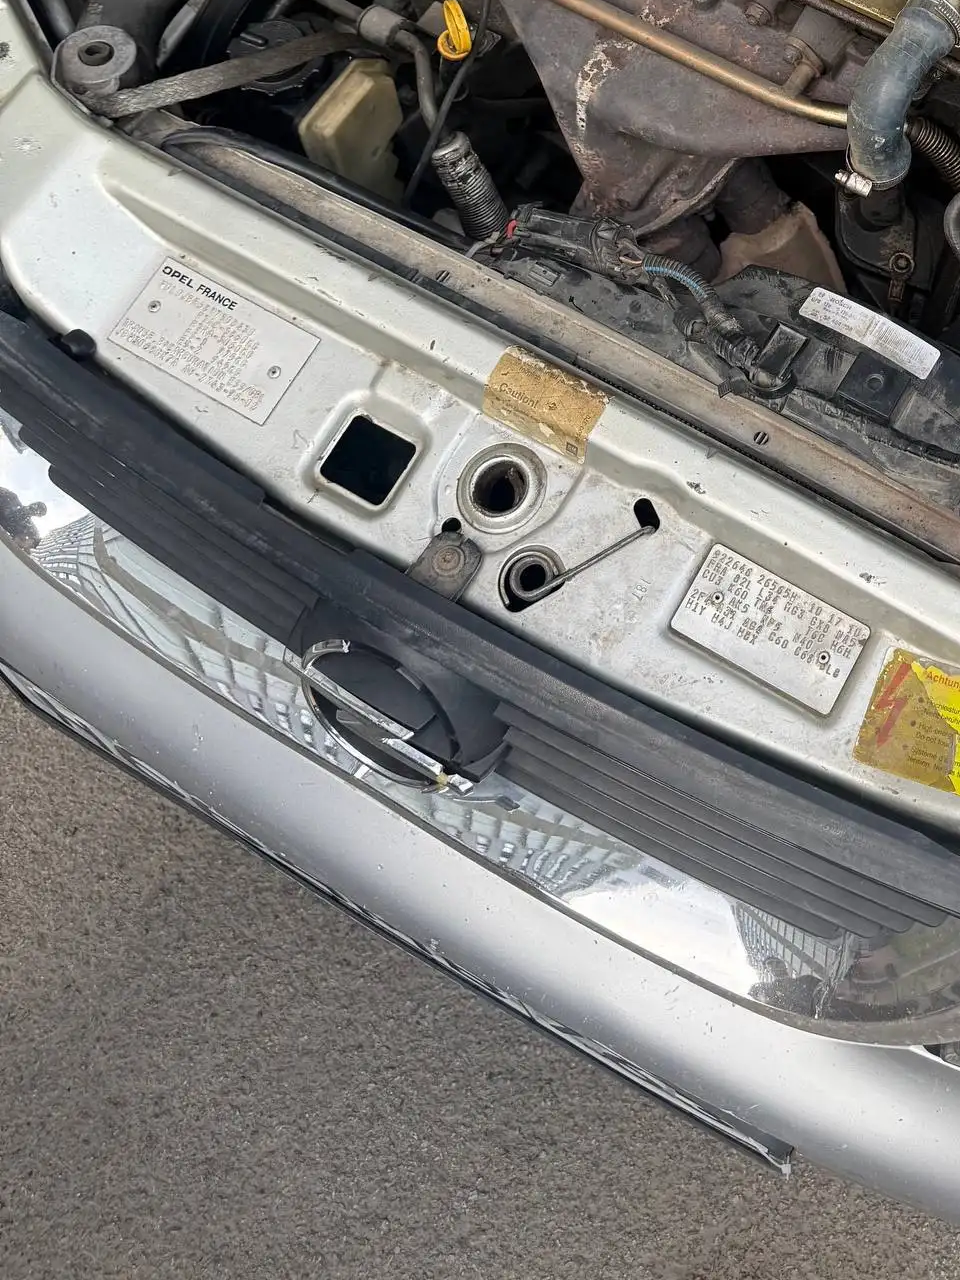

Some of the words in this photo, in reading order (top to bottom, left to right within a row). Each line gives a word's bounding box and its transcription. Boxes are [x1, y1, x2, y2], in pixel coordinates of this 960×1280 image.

[161, 265, 194, 289] OPEL
[196, 283, 238, 311] FRANCE
[499, 382, 539, 409] Caution!
